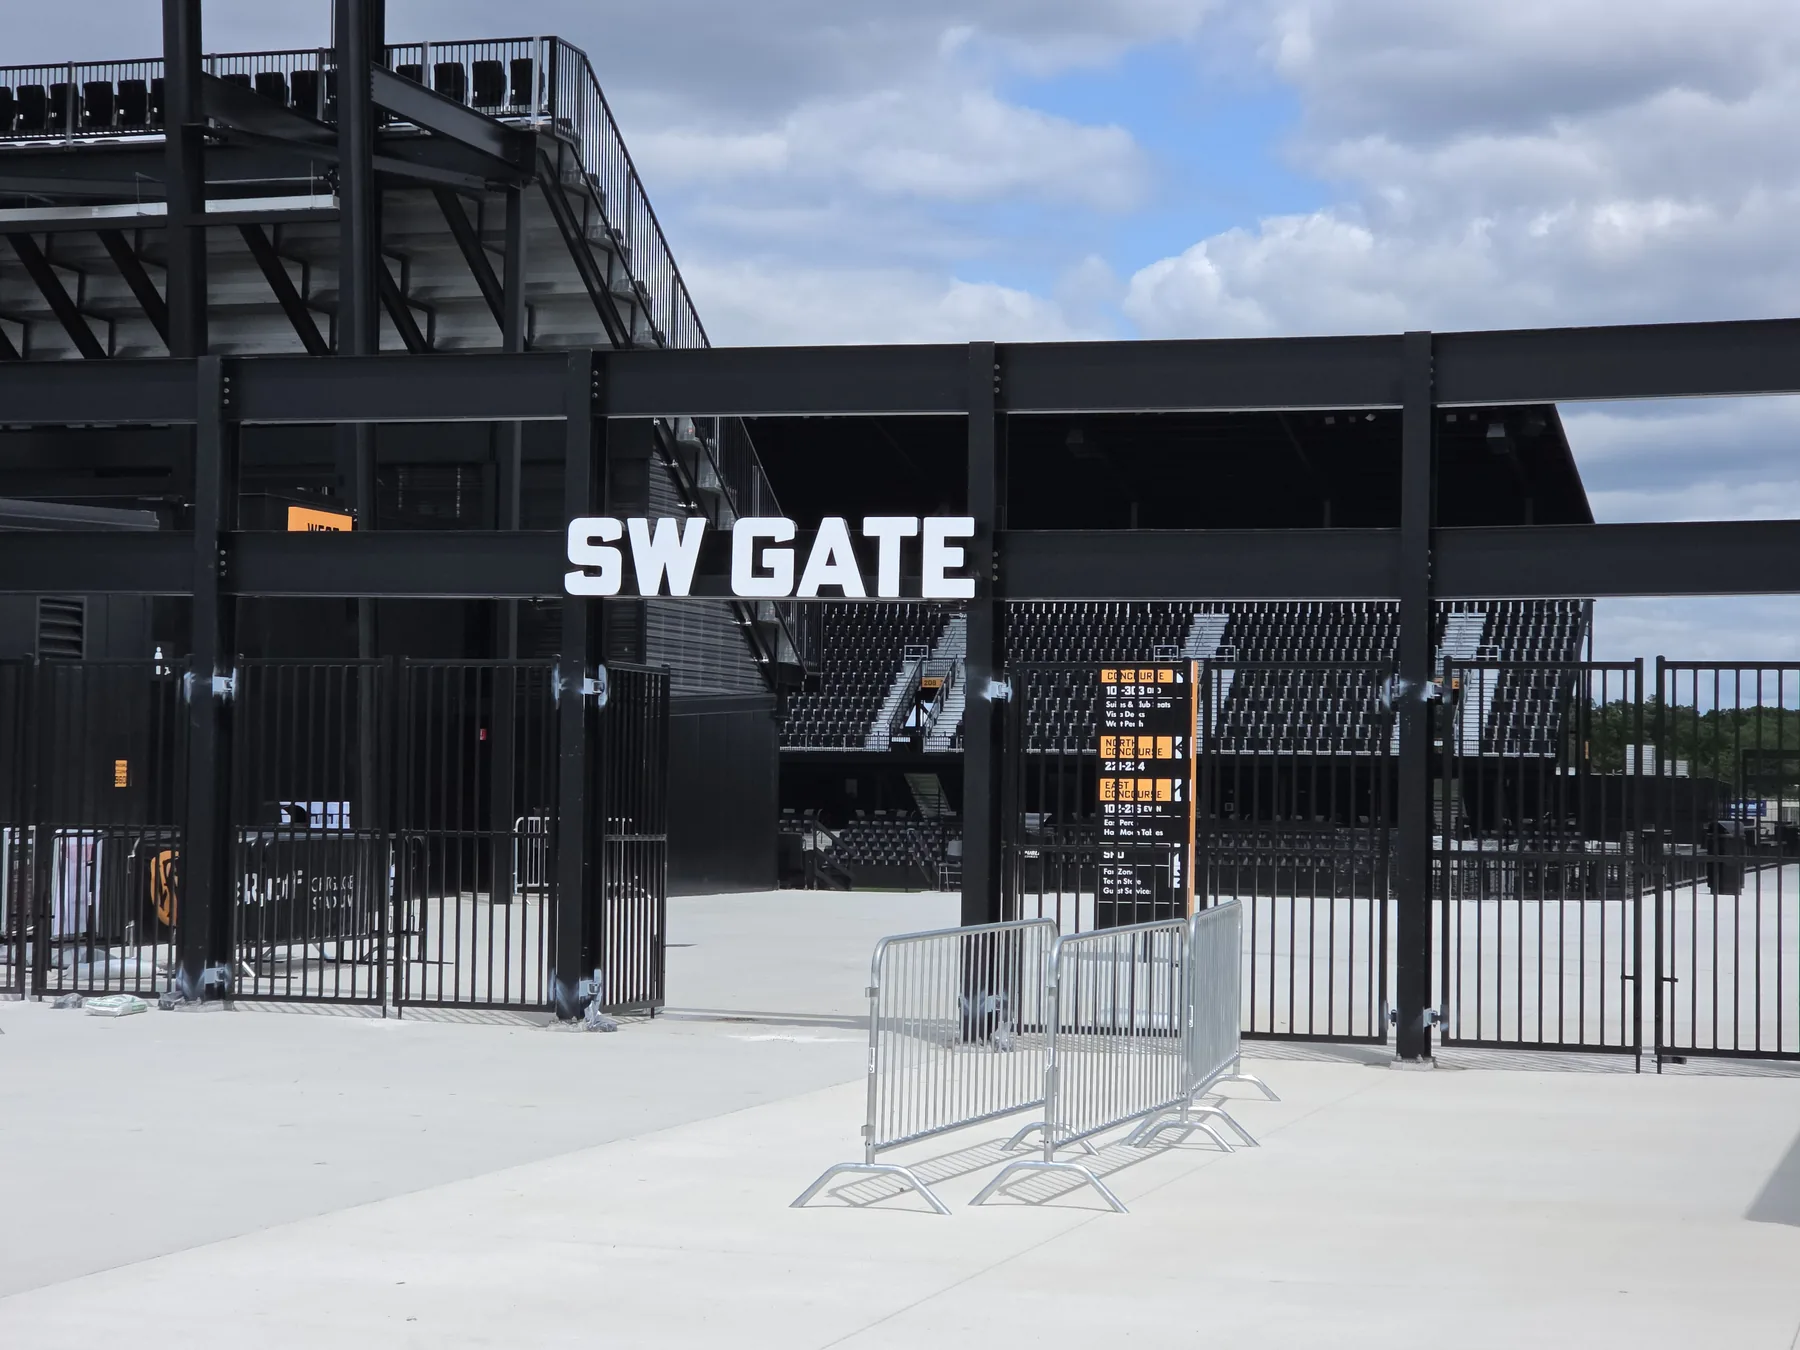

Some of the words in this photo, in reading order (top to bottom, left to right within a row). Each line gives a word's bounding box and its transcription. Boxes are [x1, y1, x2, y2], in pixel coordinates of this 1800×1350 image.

[564, 517, 707, 596] SW
[731, 516, 976, 598] GATE
[1105, 781, 1129, 790] EAST
